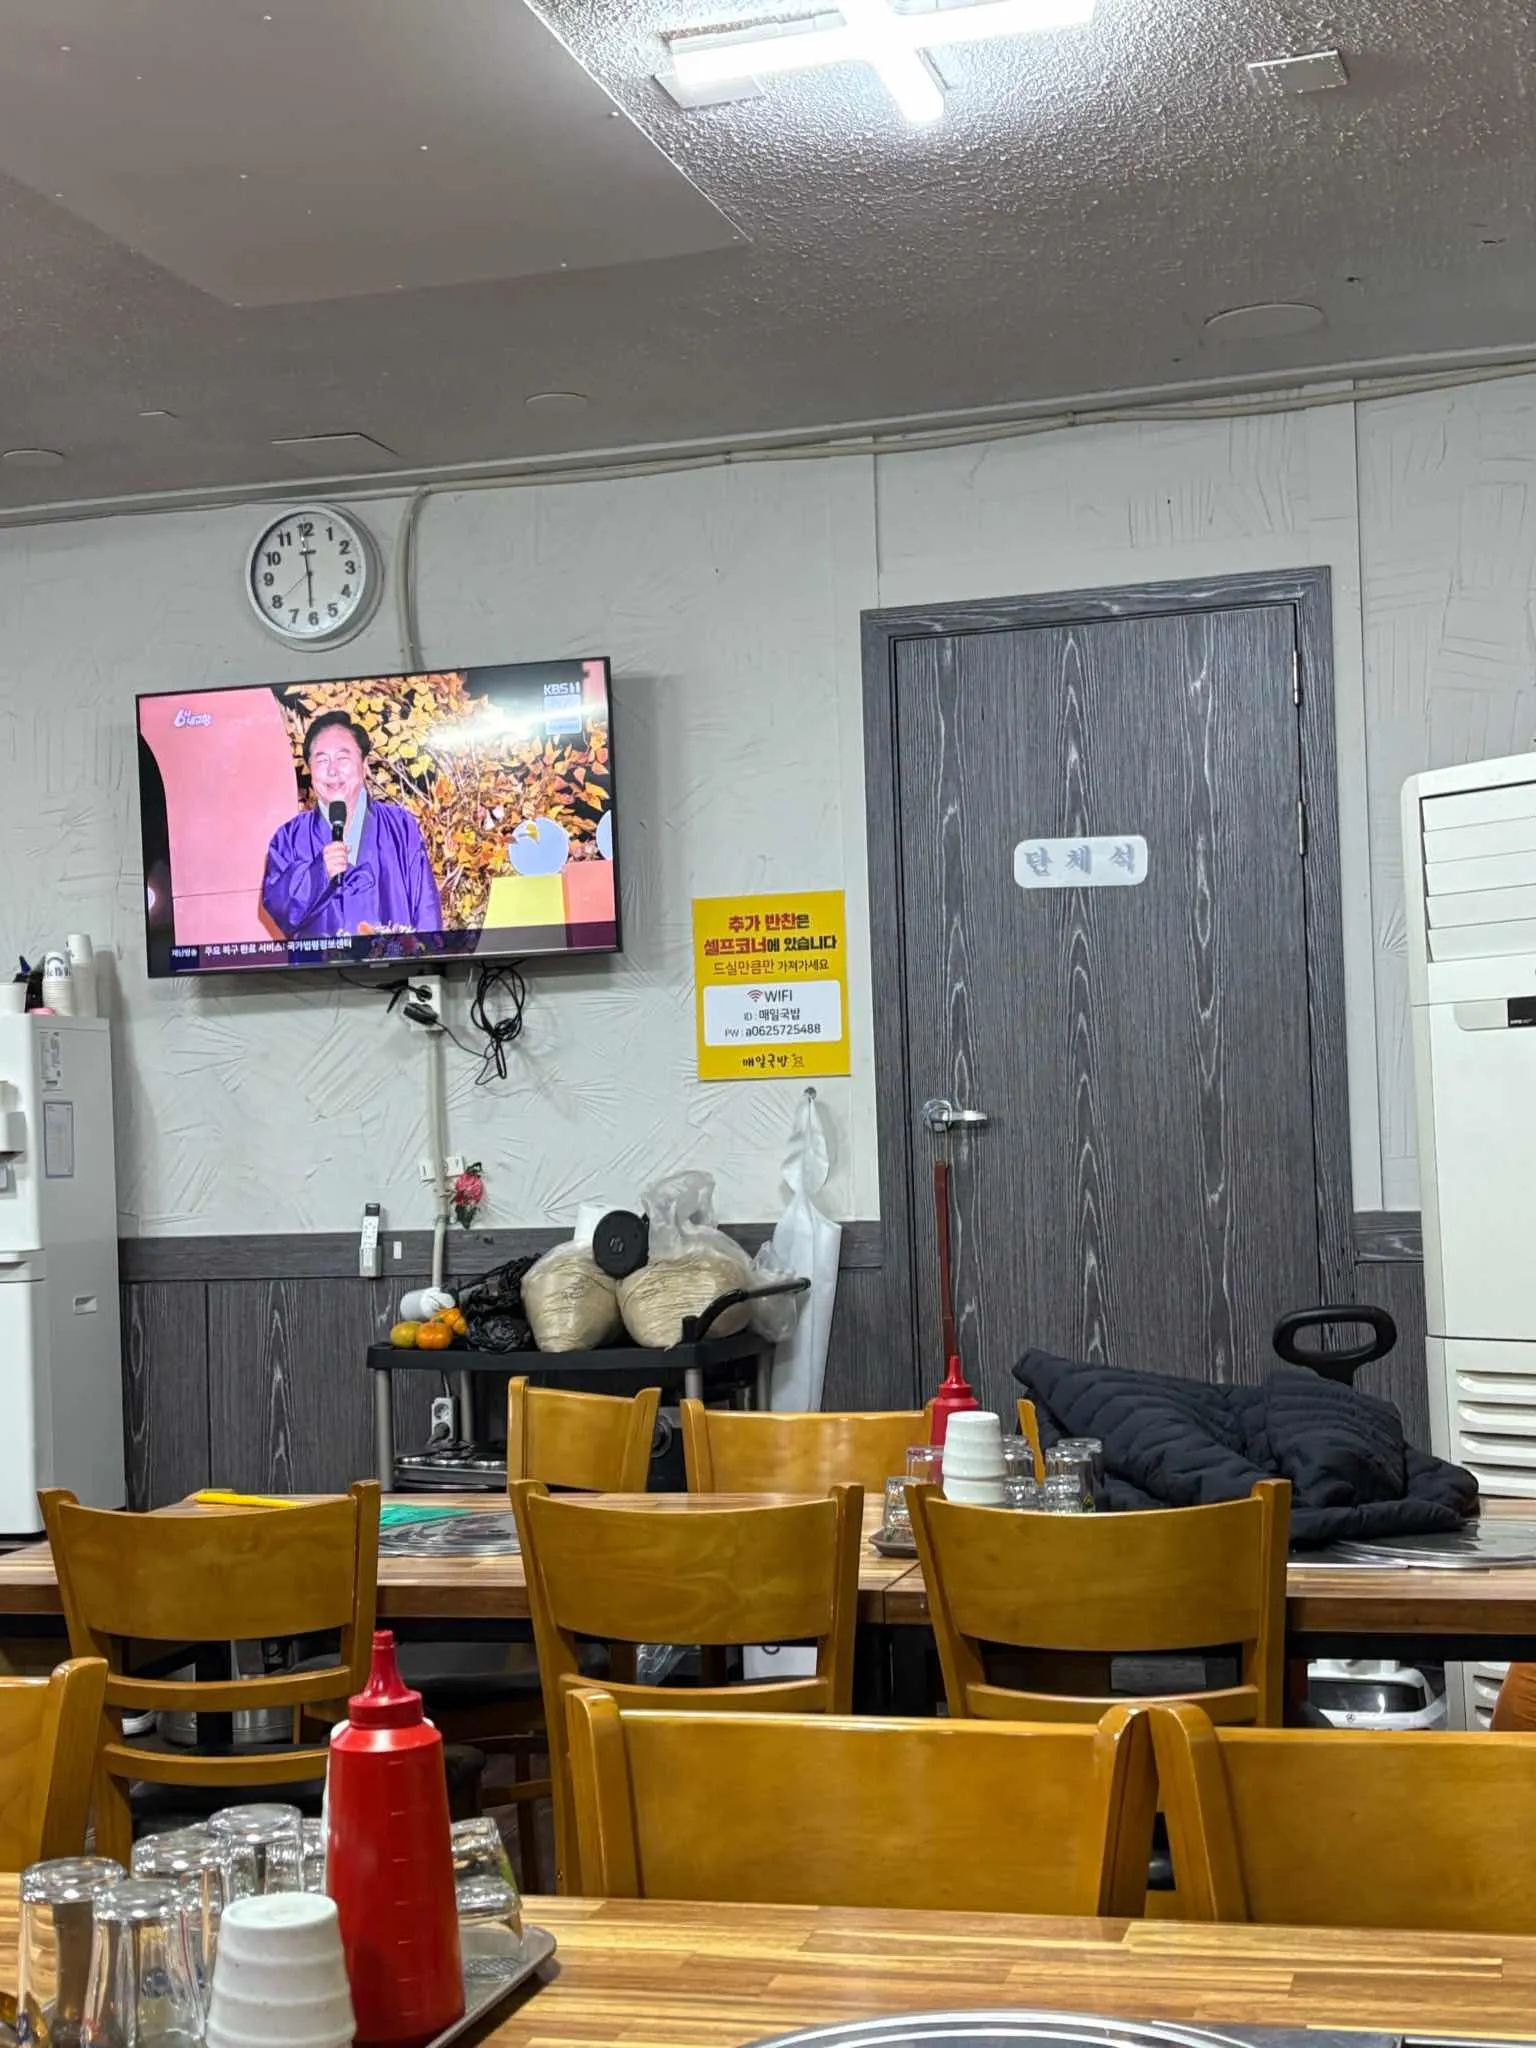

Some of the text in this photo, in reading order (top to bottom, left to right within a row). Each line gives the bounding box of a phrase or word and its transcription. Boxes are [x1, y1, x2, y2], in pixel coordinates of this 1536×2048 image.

[297, 522, 314, 537] 12
[326, 527, 333, 541] 1
[278, 532, 292, 547] 11
[340, 540, 350, 555] 2
[266, 551, 281, 566] 10
[345, 560, 356, 575] 3
[263, 572, 274, 586] 9
[341, 584, 351, 598] 4
[272, 595, 283, 609] 8
[289, 608, 299, 624] 7
[328, 603, 338, 617] 5
[308, 612, 319, 625] 6
[728, 912, 810, 933] 추가 반찬은
[205, 945, 221, 956] 주요
[704, 935, 837, 957] 셀프코너에 있습니다
[713, 958, 830, 977] 드실만큼만 가져가세요
[764, 989, 793, 1003] WIFI
[758, 1008, 800, 1021] 매일국밥
[745, 1024, 821, 1037] a0625725488
[742, 1054, 788, 1069] 매일국밥
